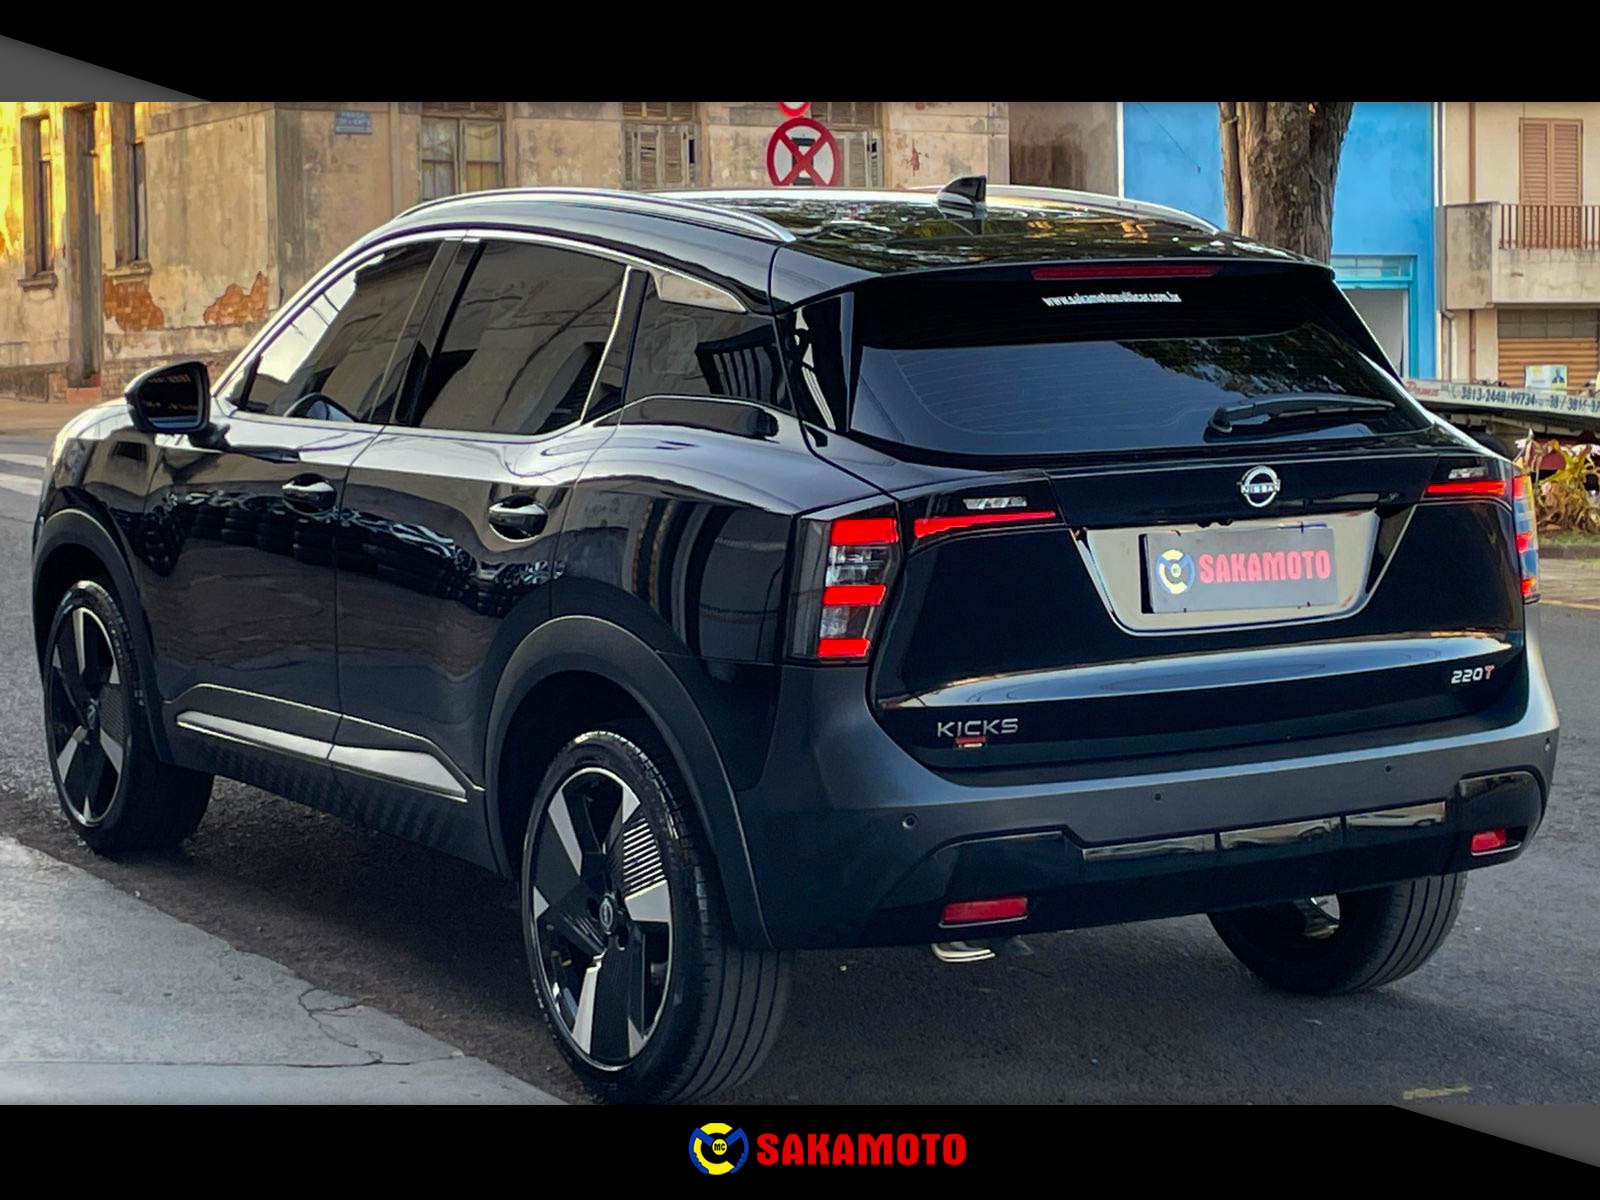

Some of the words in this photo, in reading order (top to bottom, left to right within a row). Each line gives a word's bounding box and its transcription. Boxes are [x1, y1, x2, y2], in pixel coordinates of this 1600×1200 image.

[1240, 479, 1281, 494] NISSAN
[1199, 549, 1332, 584] SAKAMOTO
[1450, 664, 1495, 685] 220T
[937, 718, 1019, 738] KICKS
